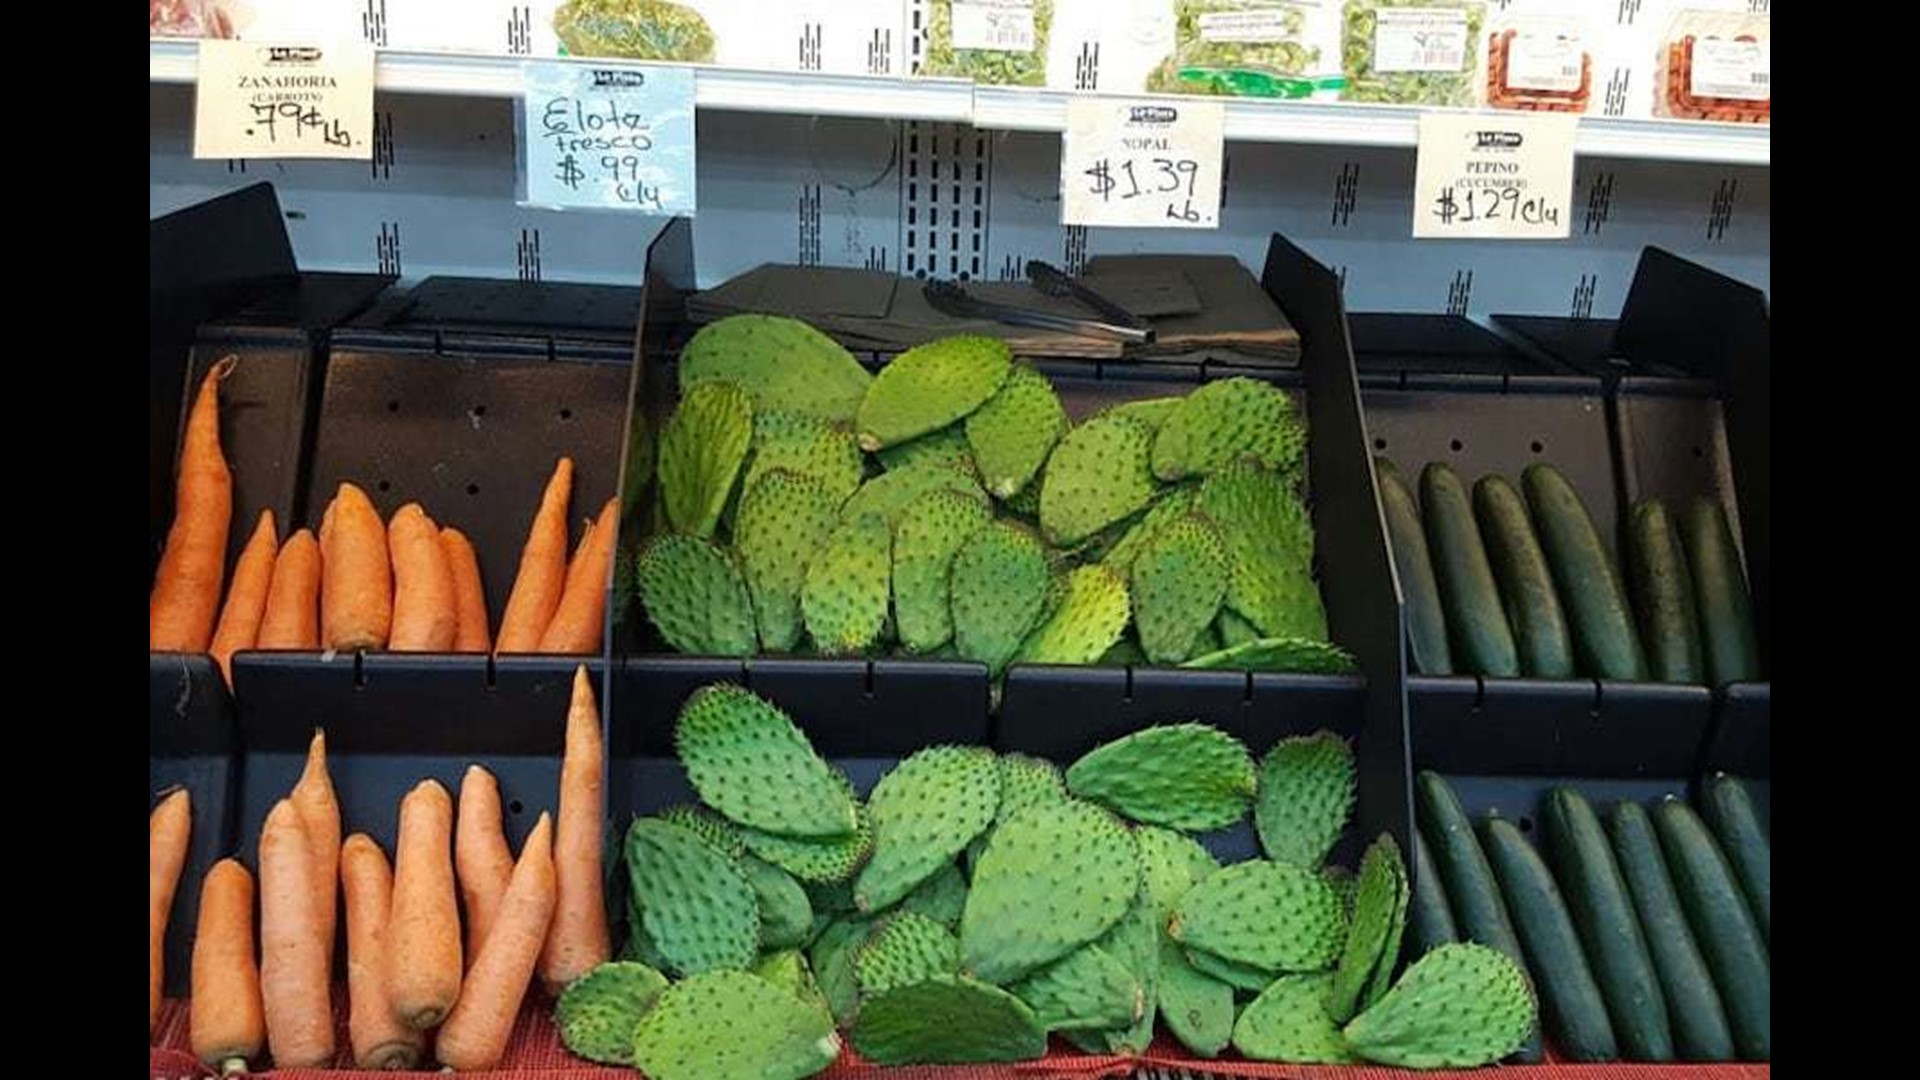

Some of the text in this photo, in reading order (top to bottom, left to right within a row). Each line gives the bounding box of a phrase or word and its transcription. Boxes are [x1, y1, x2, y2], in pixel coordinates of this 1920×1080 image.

[238, 76, 338, 88] ZANAHORIA
[1122, 138, 1172, 150] NOPAL
[1466, 162, 1519, 174] PEPINO
[1085, 158, 1198, 202] $1.39
[1432, 186, 1520, 225] $1.29
